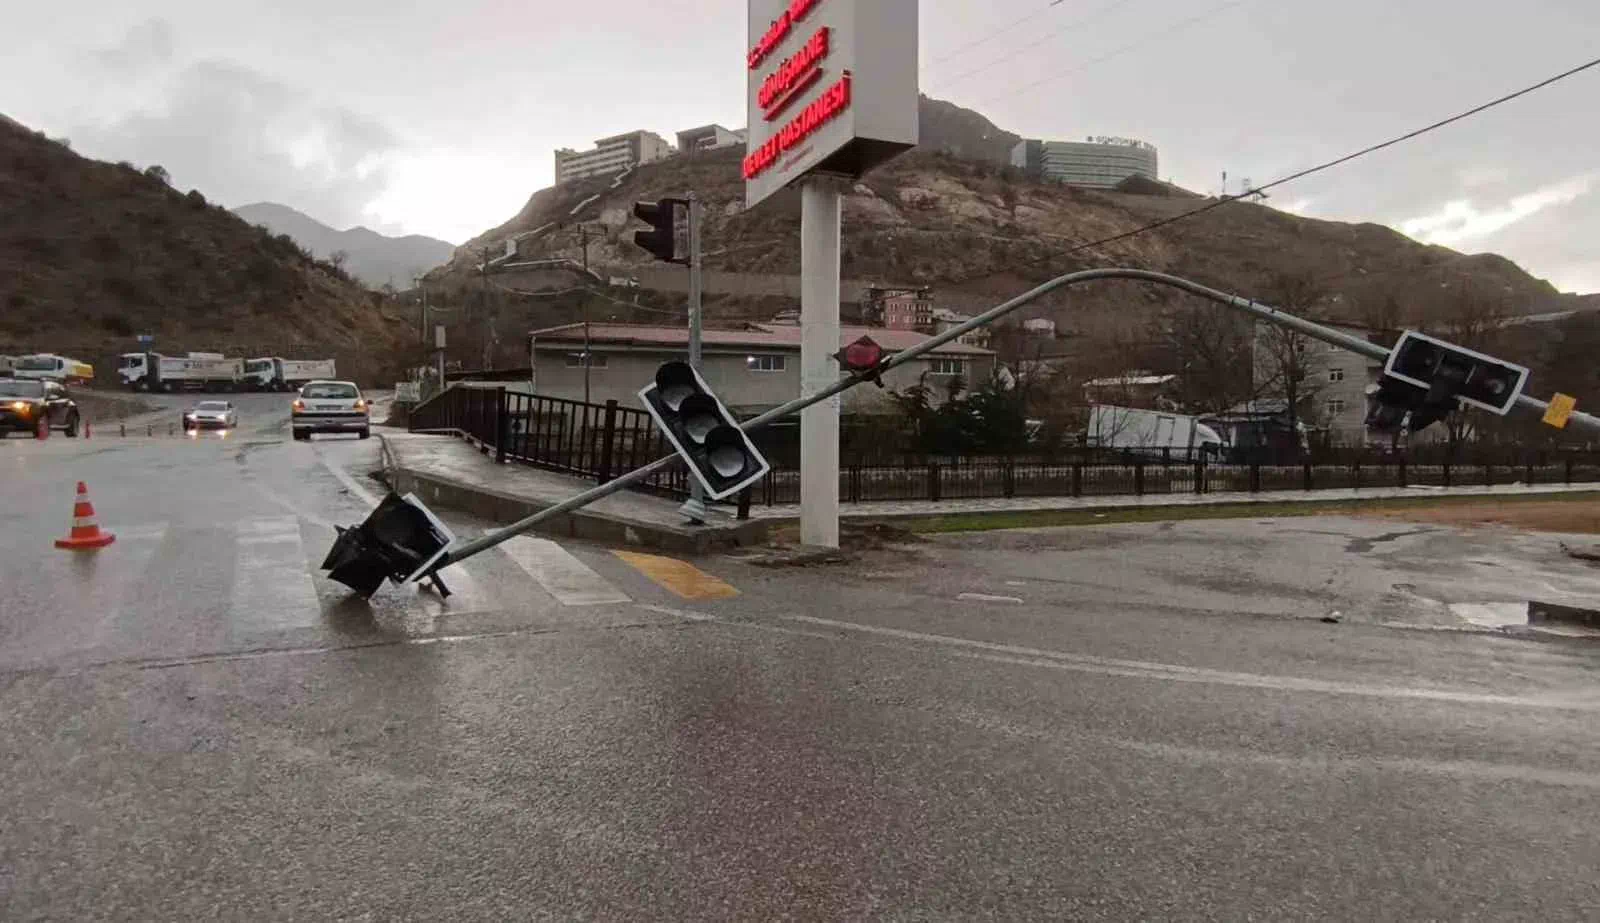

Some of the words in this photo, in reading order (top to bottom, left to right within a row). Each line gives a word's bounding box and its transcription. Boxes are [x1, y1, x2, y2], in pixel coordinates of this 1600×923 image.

[757, 26, 829, 108] GÜMÜŞHANE
[742, 133, 780, 179] DEVLET
[779, 70, 851, 150] HASTANESİ
